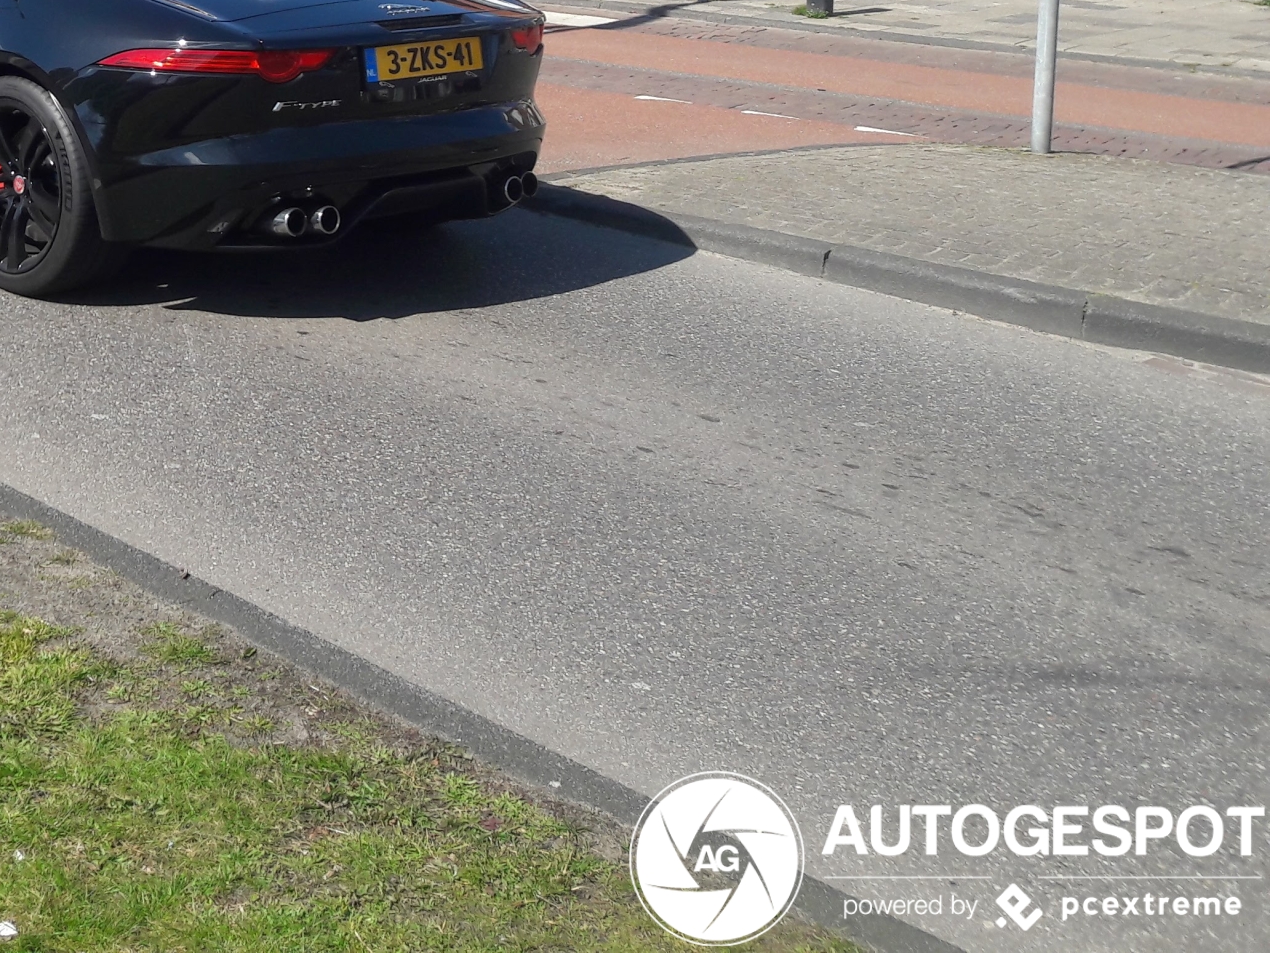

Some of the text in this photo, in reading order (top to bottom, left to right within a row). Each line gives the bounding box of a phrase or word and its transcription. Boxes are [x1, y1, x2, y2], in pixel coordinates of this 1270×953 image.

[387, 42, 473, 74] 3-ZKS-41
[418, 75, 448, 83] JAGUAR
[272, 99, 342, 112] F-TYPE
